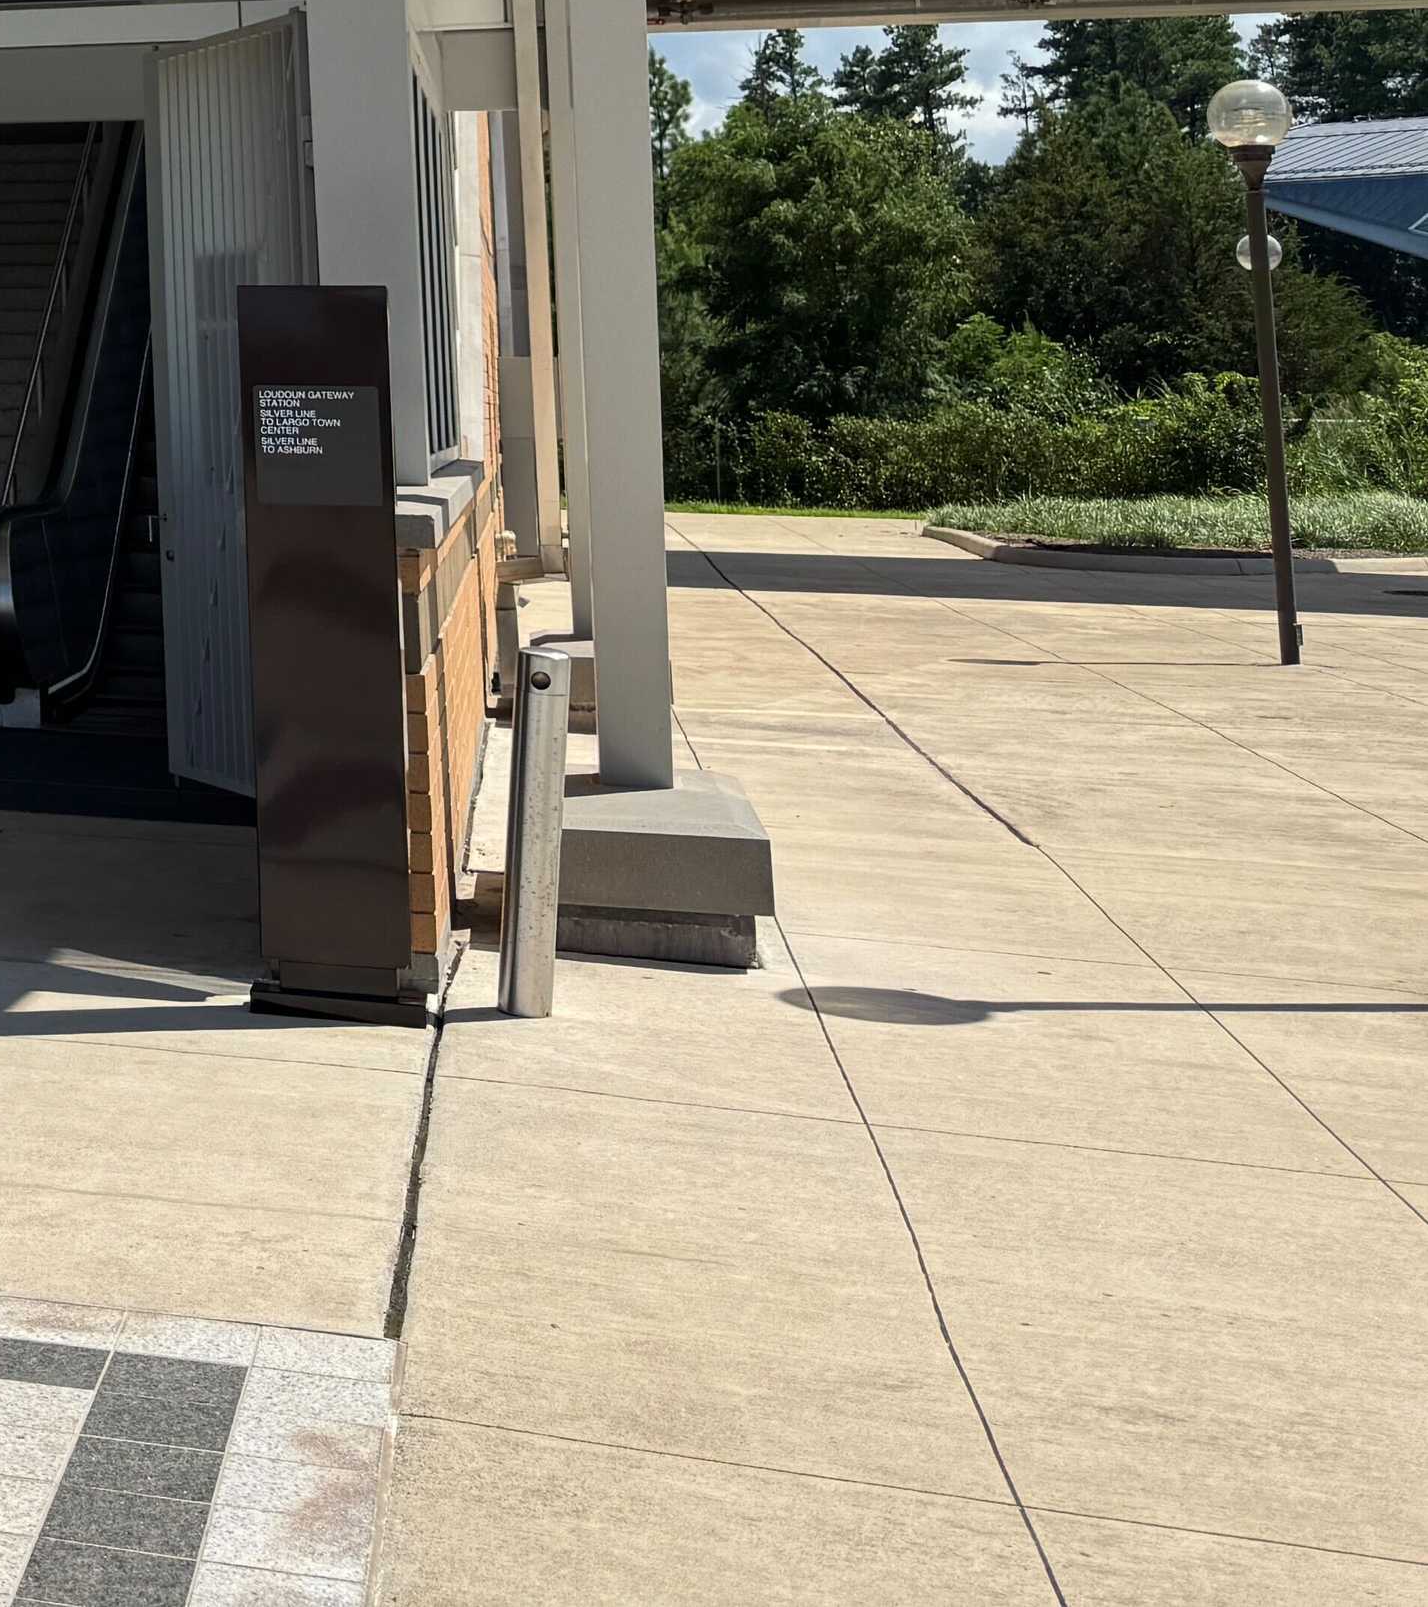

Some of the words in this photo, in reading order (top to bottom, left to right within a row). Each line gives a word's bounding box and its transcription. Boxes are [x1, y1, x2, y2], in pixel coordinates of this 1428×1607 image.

[258, 390, 306, 399] LOUDOUN
[307, 391, 354, 400] GATEWAY
[259, 399, 300, 407] STATION
[260, 409, 293, 418] SILVER
[295, 410, 317, 418] LINE
[261, 418, 274, 426] TO
[276, 418, 310, 426] LARGO
[312, 418, 341, 427] TOWN
[260, 426, 299, 435] CENTER
[261, 437, 294, 445] SILVER
[296, 437, 318, 446] LINE
[262, 445, 275, 454] TO
[277, 446, 323, 454] ASHBURN
